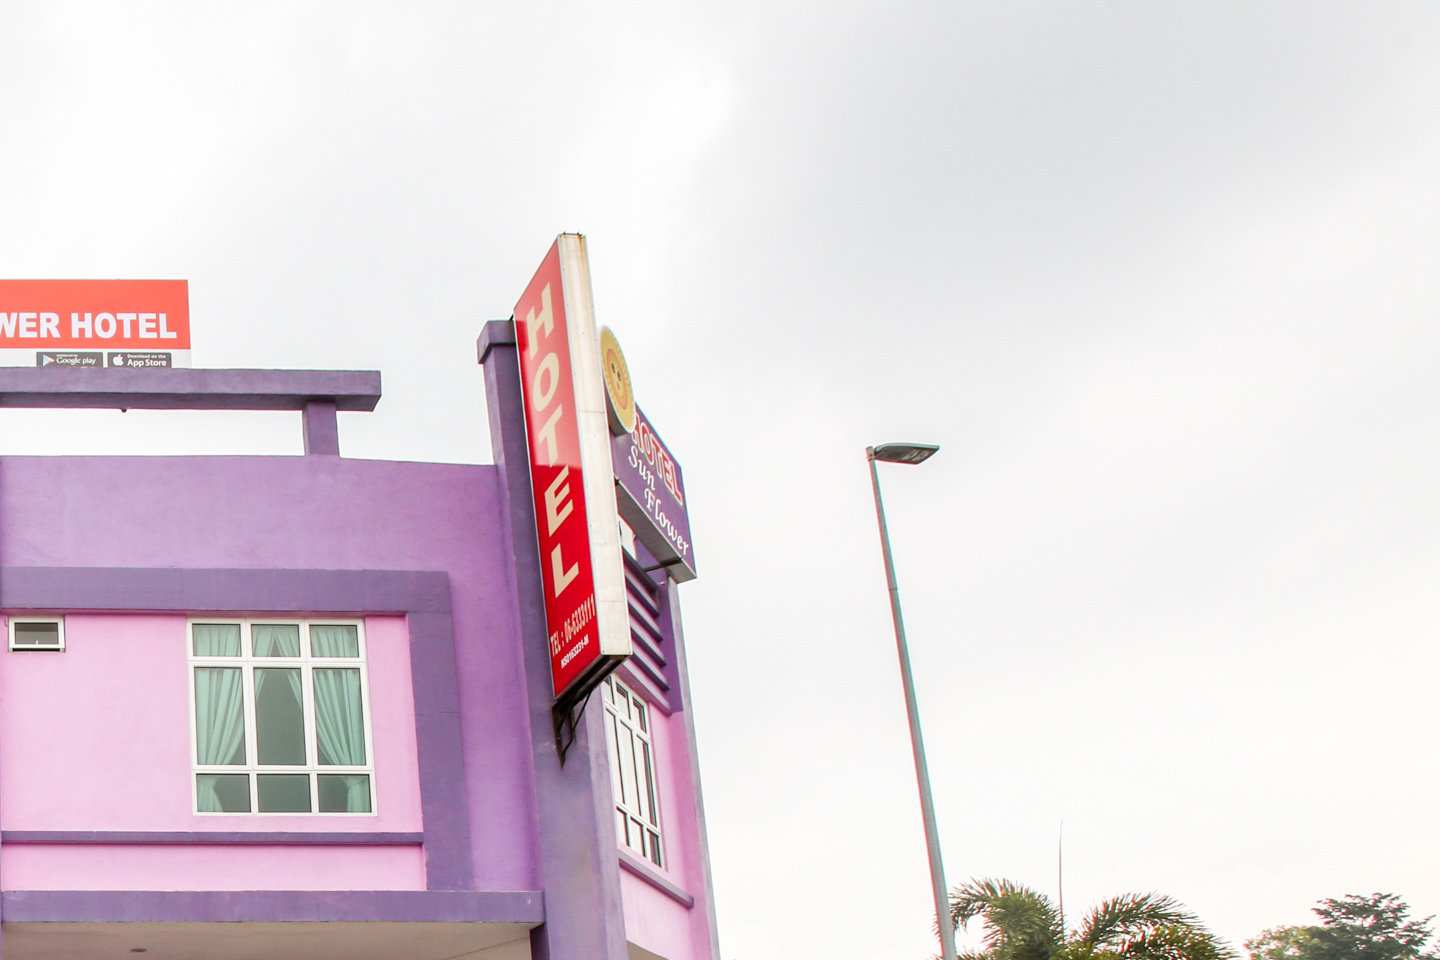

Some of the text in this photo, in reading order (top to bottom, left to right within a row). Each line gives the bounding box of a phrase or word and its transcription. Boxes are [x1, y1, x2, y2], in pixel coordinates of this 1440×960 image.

[71, 312, 178, 340] HOTEL
[56, 356, 96, 366] Google play
[127, 359, 167, 367] App Store
[526, 281, 579, 598] HOTEL
[631, 413, 683, 506] HOTEL
[628, 445, 655, 490] Sun
[644, 488, 689, 556] Flower
